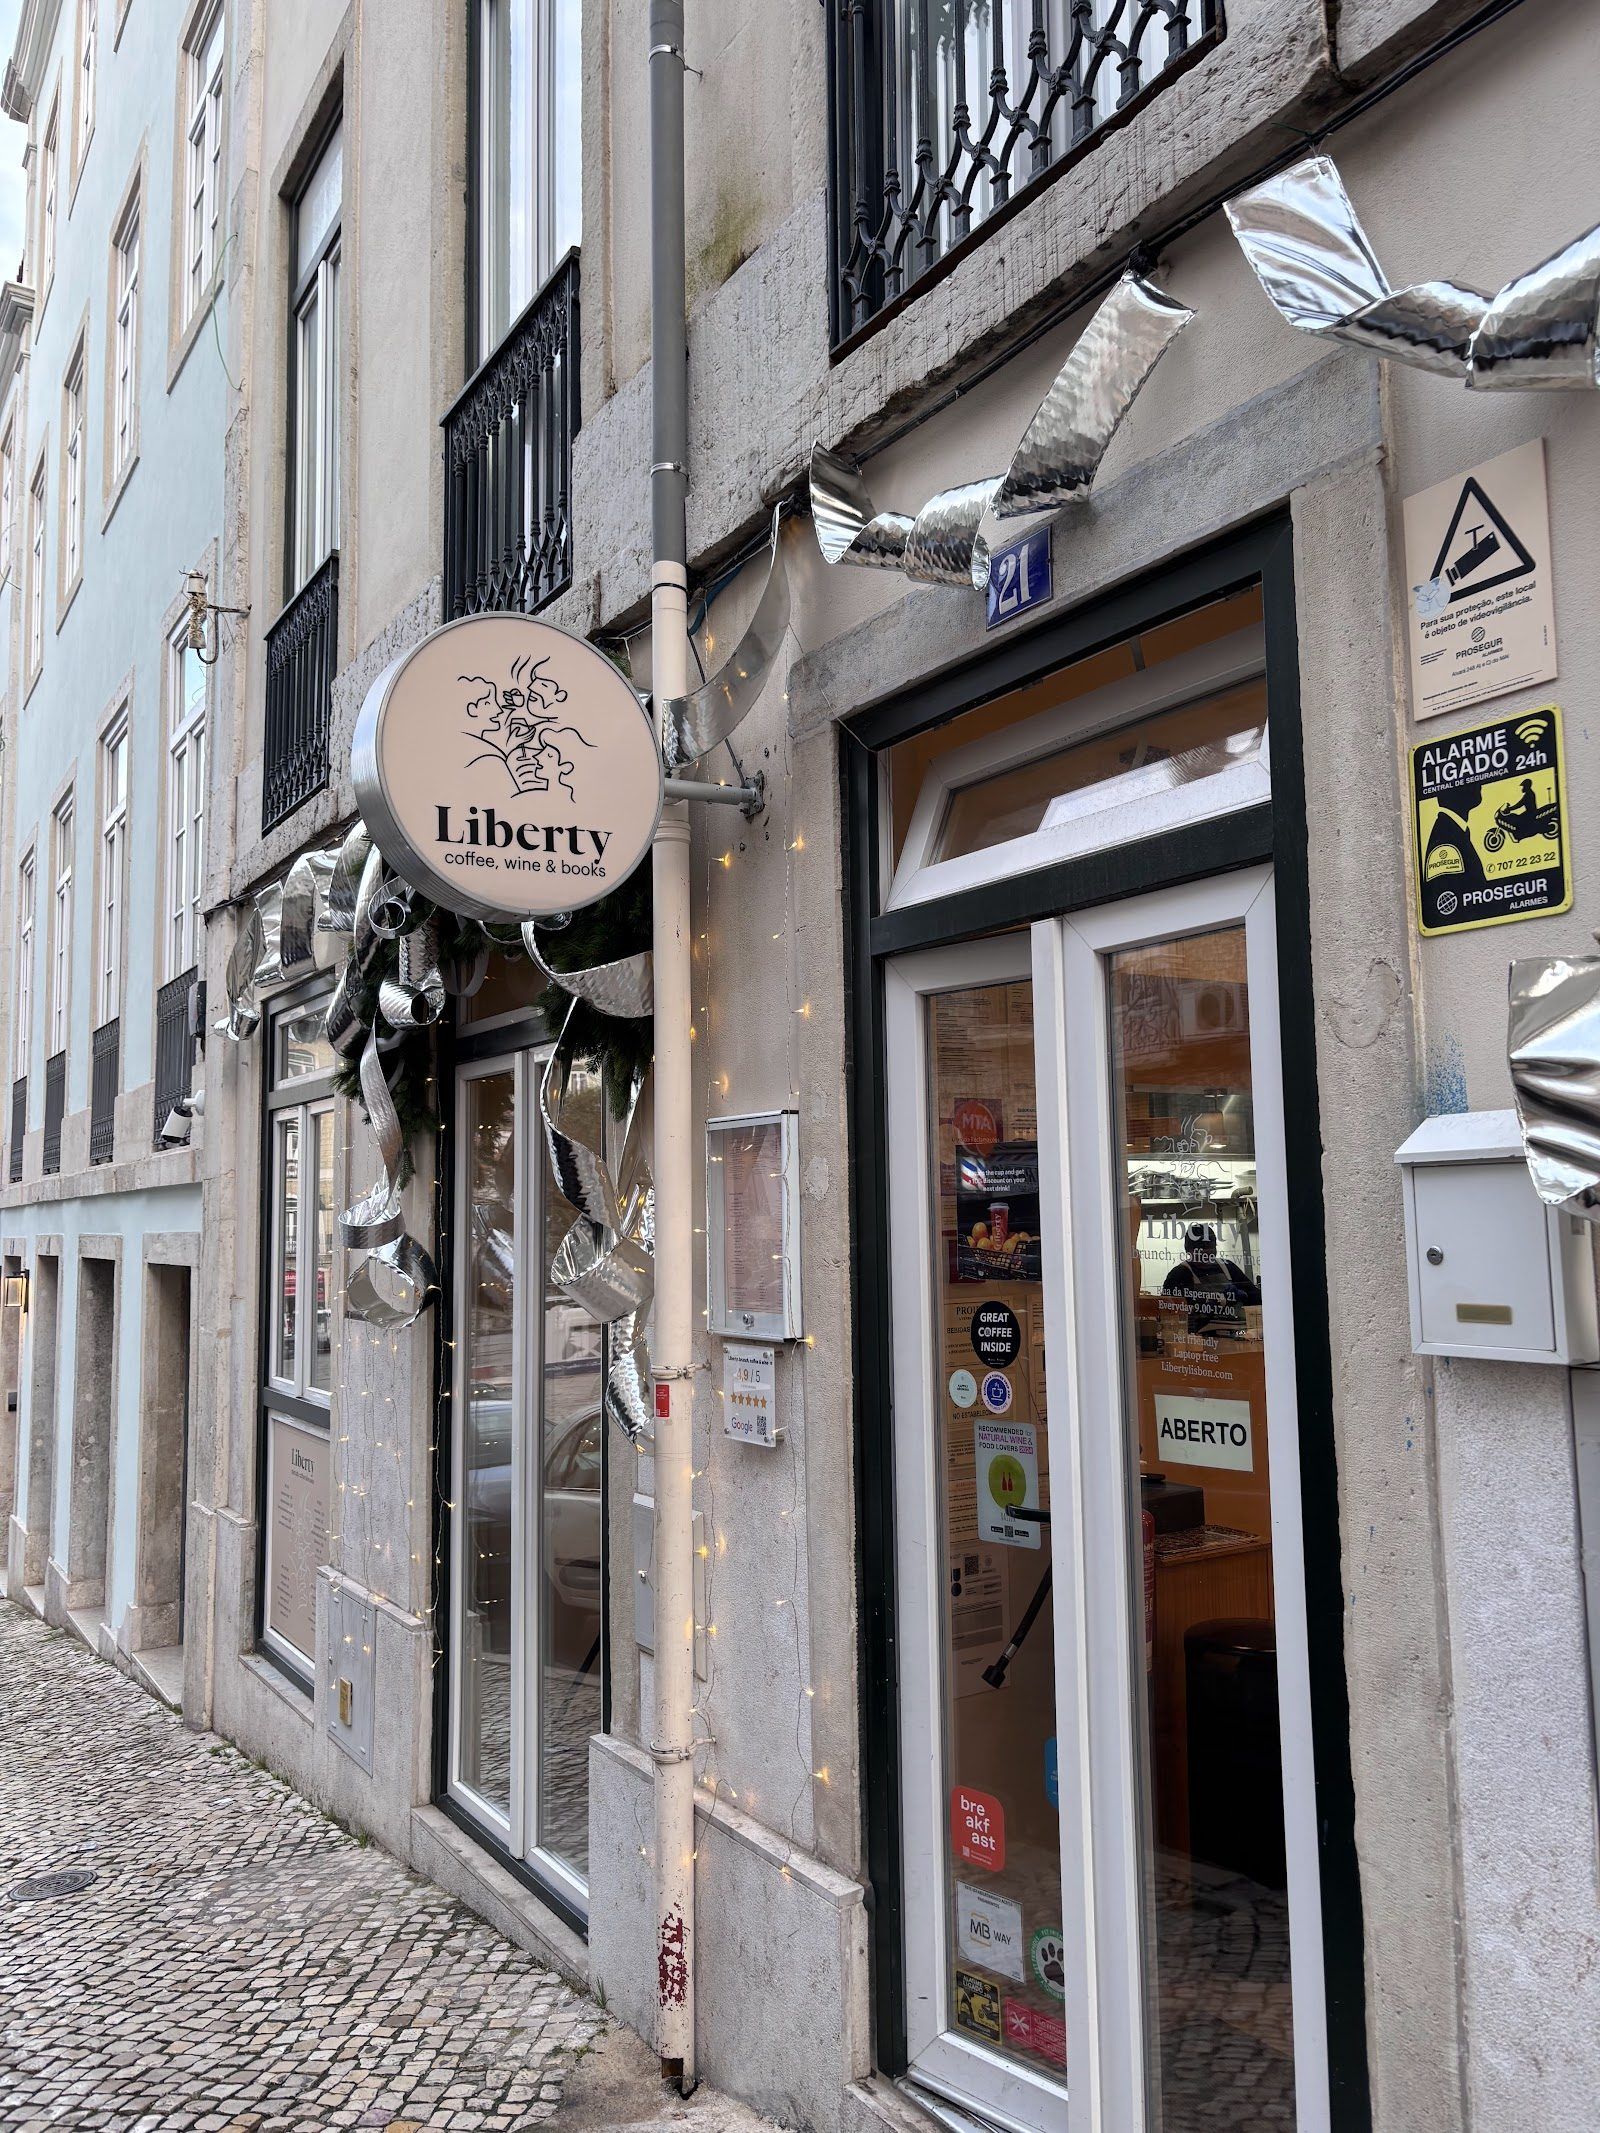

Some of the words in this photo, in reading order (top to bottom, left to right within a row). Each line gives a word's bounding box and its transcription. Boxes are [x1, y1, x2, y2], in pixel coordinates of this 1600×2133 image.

[999, 543, 1032, 615] 21
[1420, 618, 1439, 631] Para
[1440, 613, 1454, 623] sua
[1455, 599, 1494, 619] proteção,
[1496, 591, 1513, 602] este
[1515, 580, 1536, 595] local
[1425, 631, 1430, 639] é
[1431, 623, 1456, 638] objeto
[1458, 617, 1468, 628] de
[1469, 597, 1533, 623] videovigilância.
[1455, 637, 1503, 660] PROSEGUR
[1422, 729, 1507, 767] ALARME
[1422, 748, 1509, 787] LIGADO
[1515, 750, 1547, 771] 24h
[1423, 783, 1453, 795] CENTRAL
[1455, 779, 1464, 787] DE
[1465, 767, 1509, 785] SEGURANÇA
[435, 804, 613, 864] Liberty
[445, 851, 499, 870] coffee,
[505, 857, 541, 872] wine
[545, 860, 556, 873] &
[562, 861, 606, 877] books
[1428, 858, 1460, 870] PROSEGUR
[1497, 860, 1513, 872] 707
[1516, 857, 1528, 868] 22
[1530, 854, 1541, 865] 23
[1543, 851, 1556, 862] 22
[1462, 878, 1548, 907] PROSEGUR
[1509, 896, 1549, 910] ALARMES
[1146, 1213, 1242, 1248] Liberty
[1130, 1244, 1175, 1264] brunch,
[1179, 1248, 1217, 1264] coffee
[1219, 1251, 1229, 1264] &
[1156, 1285, 1171, 1296] Rua
[1173, 1286, 1182, 1296] da
[1183, 1287, 1225, 1302] Esperança
[1226, 1291, 1236, 1302] 21
[980, 1312, 1010, 1323] GREAT
[1158, 1300, 1194, 1315] Everyday
[1194, 1303, 1235, 1316] 9.00-17.00
[978, 1327, 1012, 1338] COFFEE
[1173, 1333, 1185, 1344] Pet
[1187, 1332, 1219, 1348] friendly
[980, 1341, 1012, 1353] INSIDE
[1173, 1349, 1201, 1362] Laptop
[1202, 1350, 1219, 1363] free
[755, 1370, 761, 1383] 5
[1161, 1361, 1233, 1380] Libertylisbon.com
[731, 1416, 753, 1435] Google
[978, 1425, 1023, 1436] RECOMMENDED
[1160, 1417, 1247, 1447] ABERTO
[978, 1432, 1008, 1443] NATURAL
[1010, 1436, 1027, 1445] WINE
[979, 1441, 995, 1449] FOOD
[996, 1444, 1018, 1452] LOVERS
[291, 1448, 315, 1477] Liberty
[960, 1794, 985, 1816] bre
[966, 1815, 990, 1834] akf
[971, 1832, 996, 1851] ast
[970, 1918, 991, 1940] MB
[993, 1930, 1011, 1946] WAY
